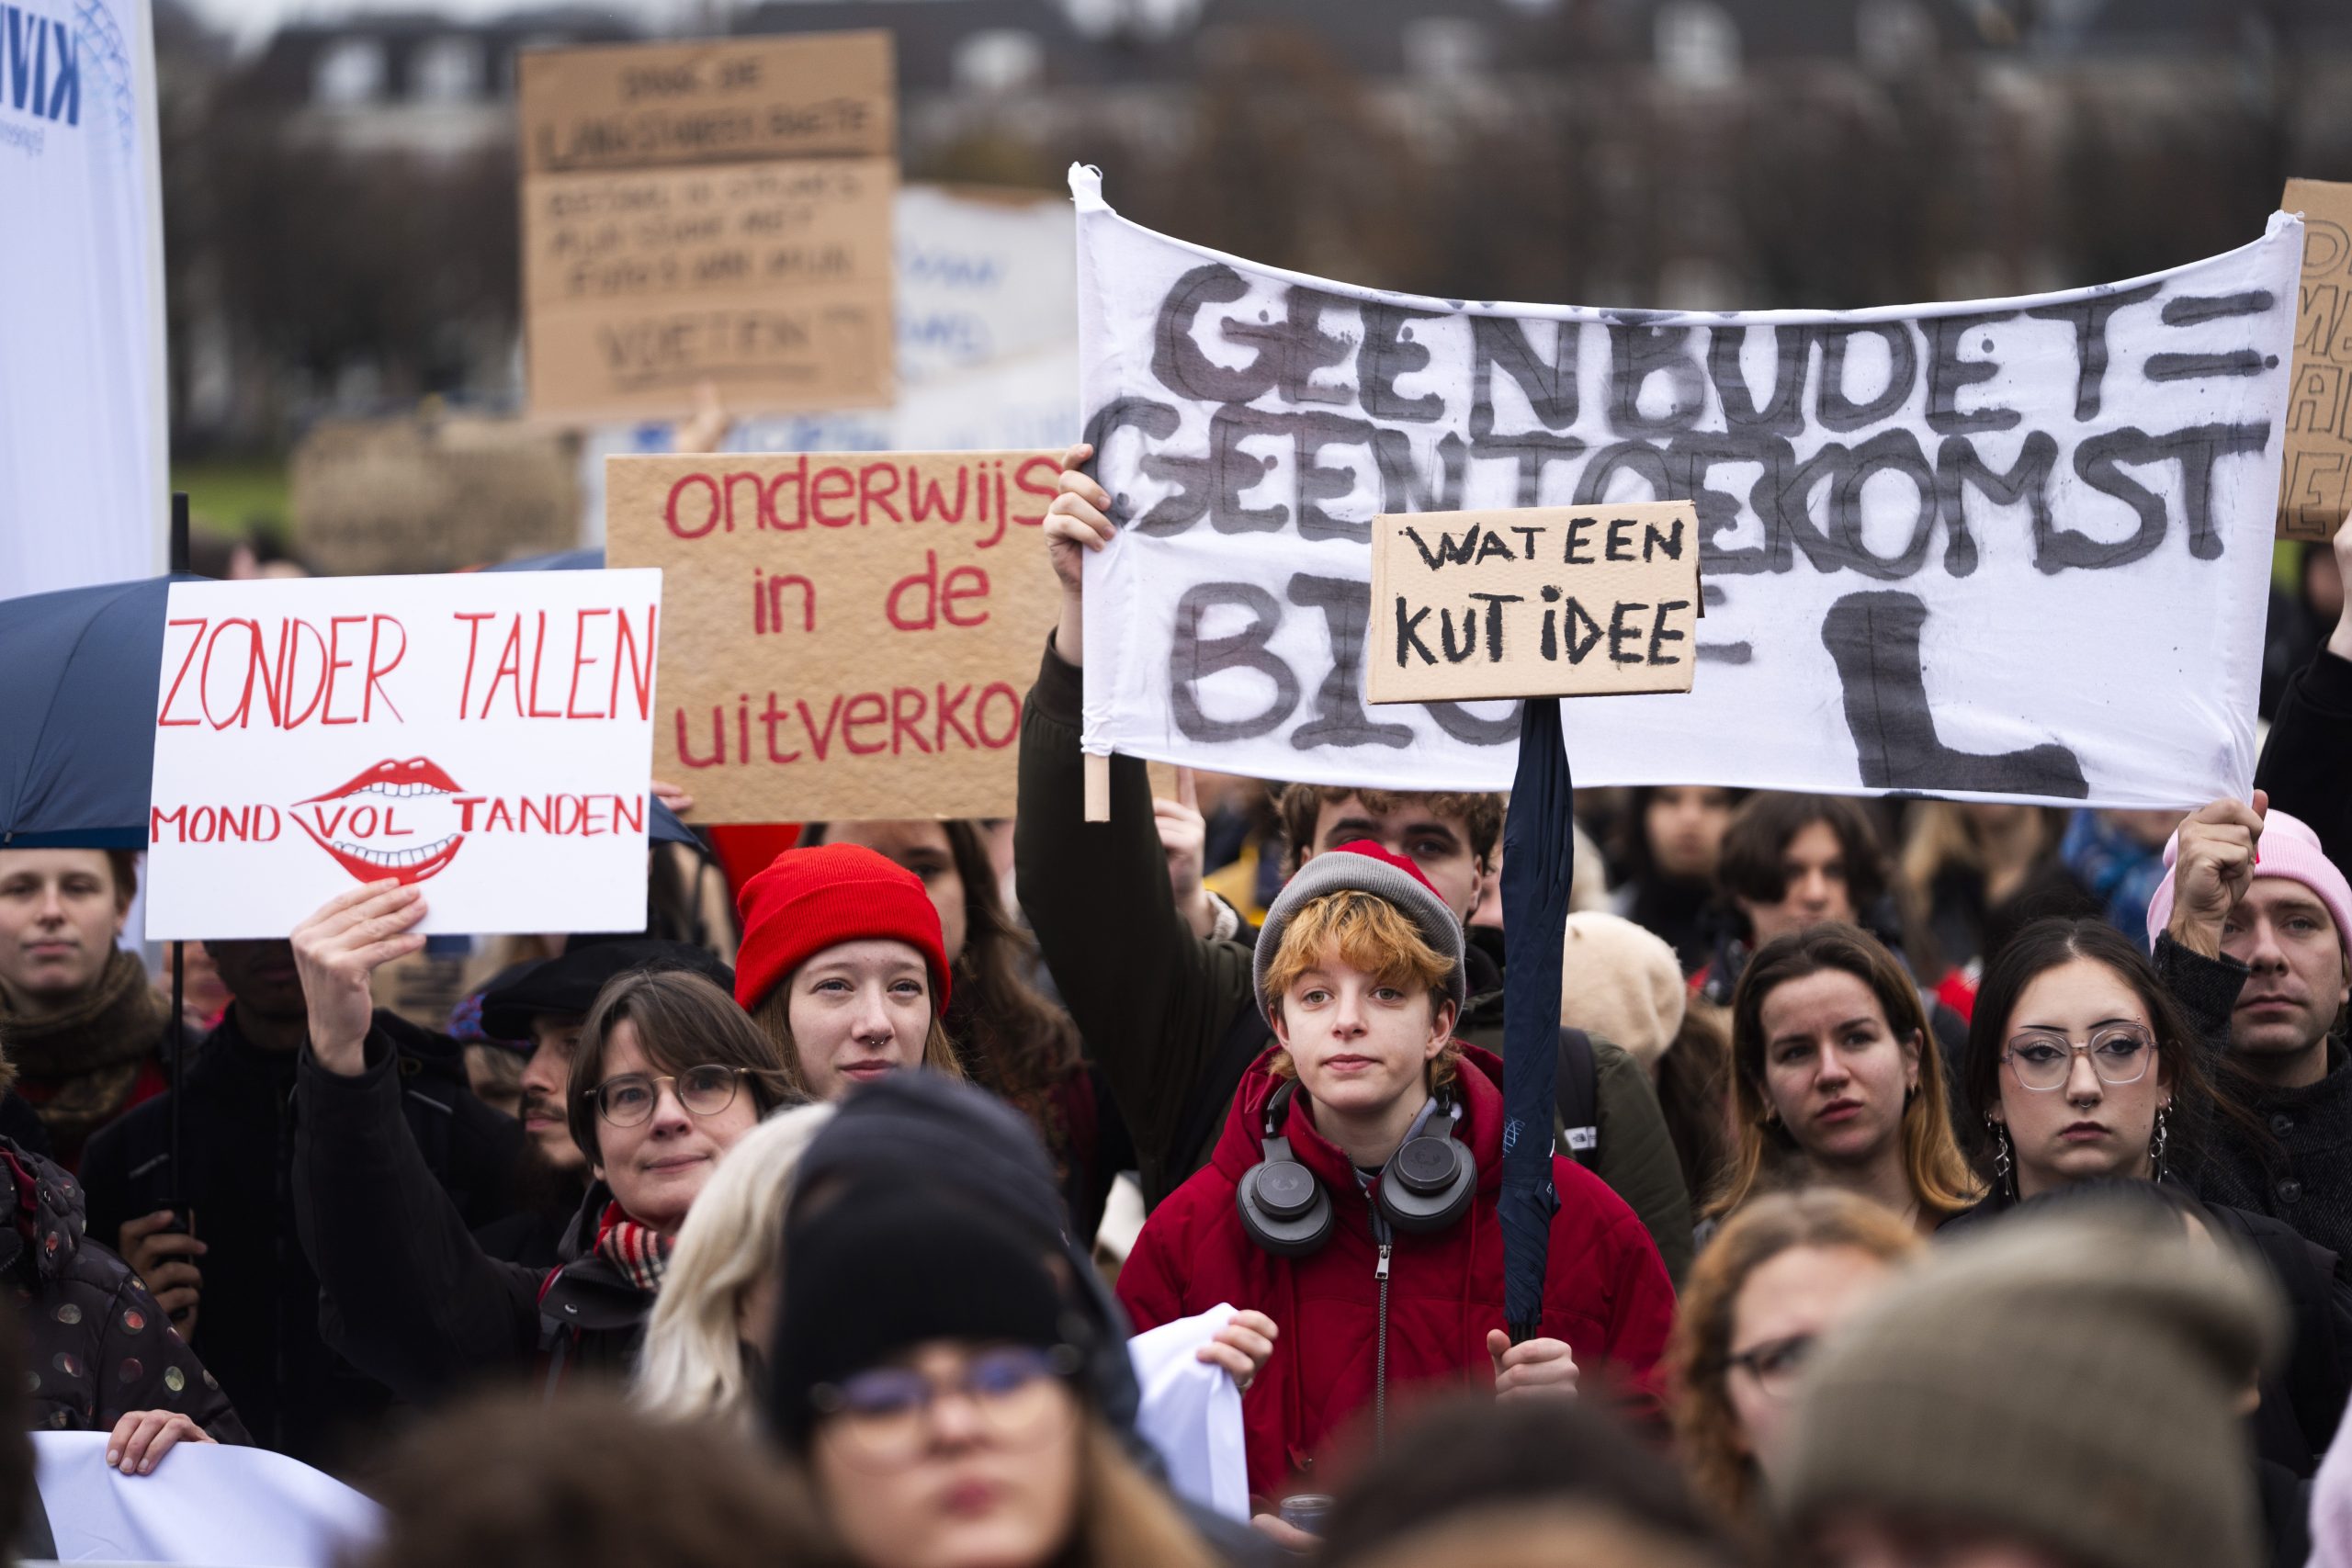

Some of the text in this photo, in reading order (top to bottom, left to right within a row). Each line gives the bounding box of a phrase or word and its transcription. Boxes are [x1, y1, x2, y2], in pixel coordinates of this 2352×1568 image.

[1151, 263, 1580, 430] GEEN
[1082, 396, 1472, 542] GEEN
[754, 548, 990, 635] in de
[1398, 517, 1685, 571] WAT EEN
[158, 604, 656, 731] ZONDER TALEN
[1170, 571, 1525, 748] BI
[1396, 592, 1525, 668] KUT
[151, 794, 643, 843] MOND VOL TANDEN
